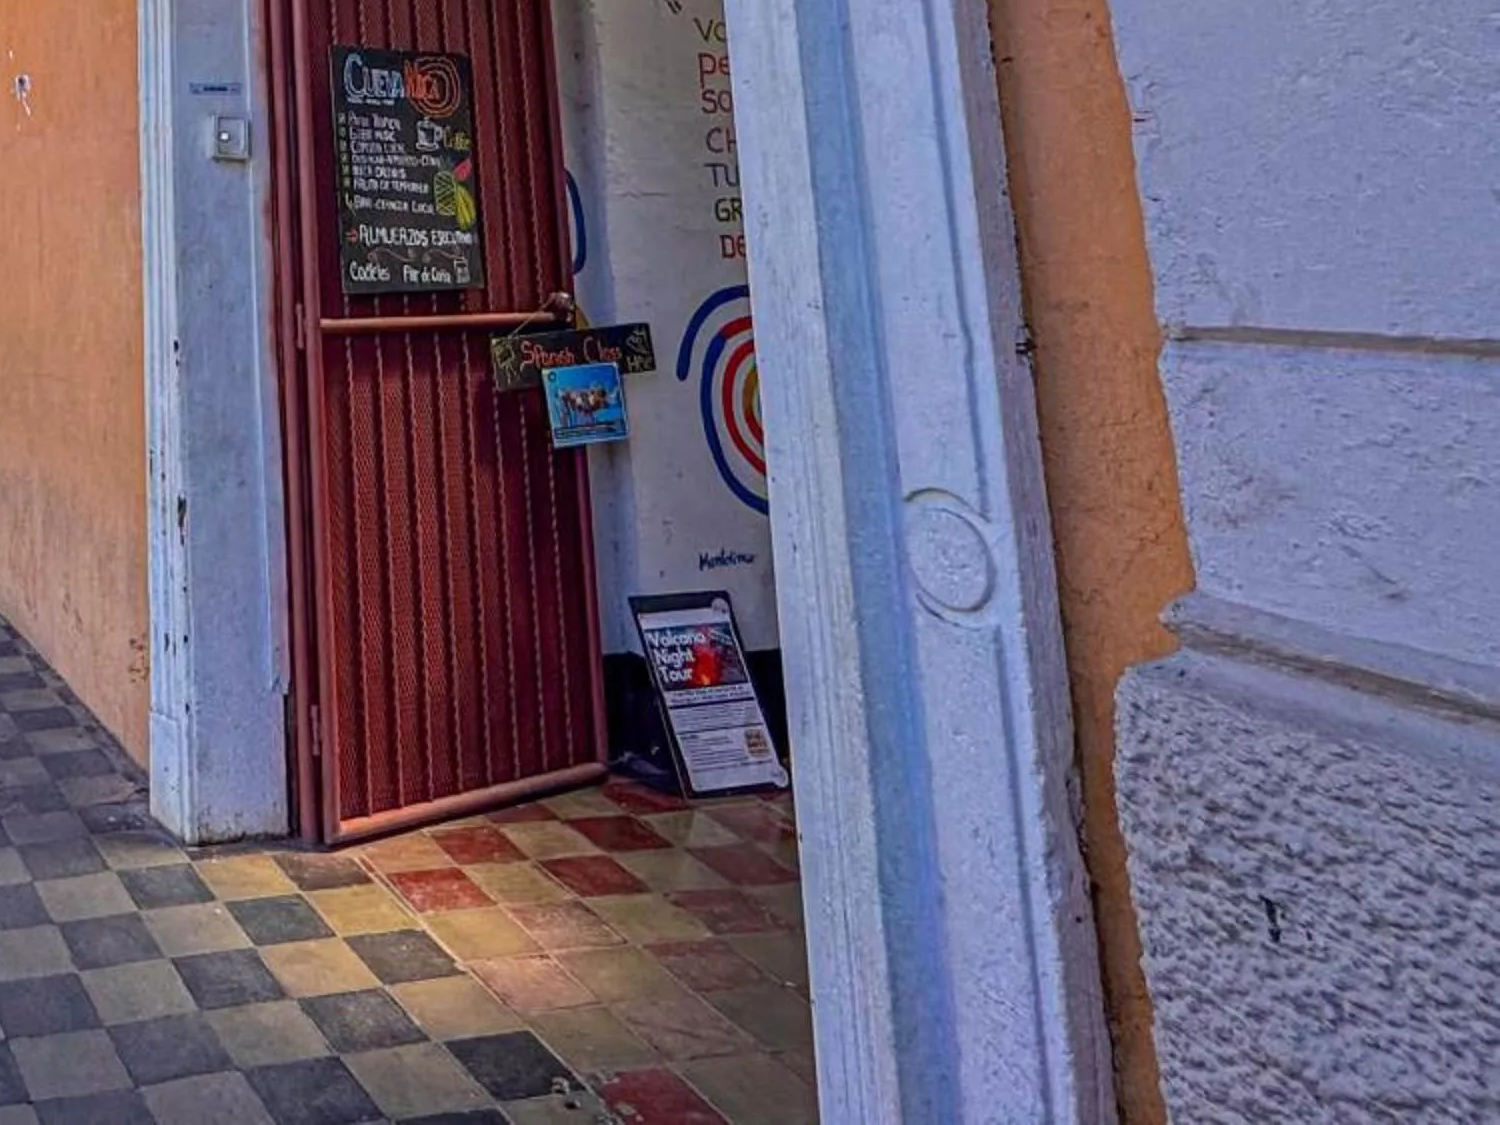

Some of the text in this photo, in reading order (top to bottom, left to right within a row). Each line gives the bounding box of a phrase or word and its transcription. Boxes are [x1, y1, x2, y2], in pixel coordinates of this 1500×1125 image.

[359, 223, 430, 247] ALMUERZOS
[645, 629, 707, 648] Volcano
[654, 645, 697, 669] Night
[659, 666, 693, 684] Tour
